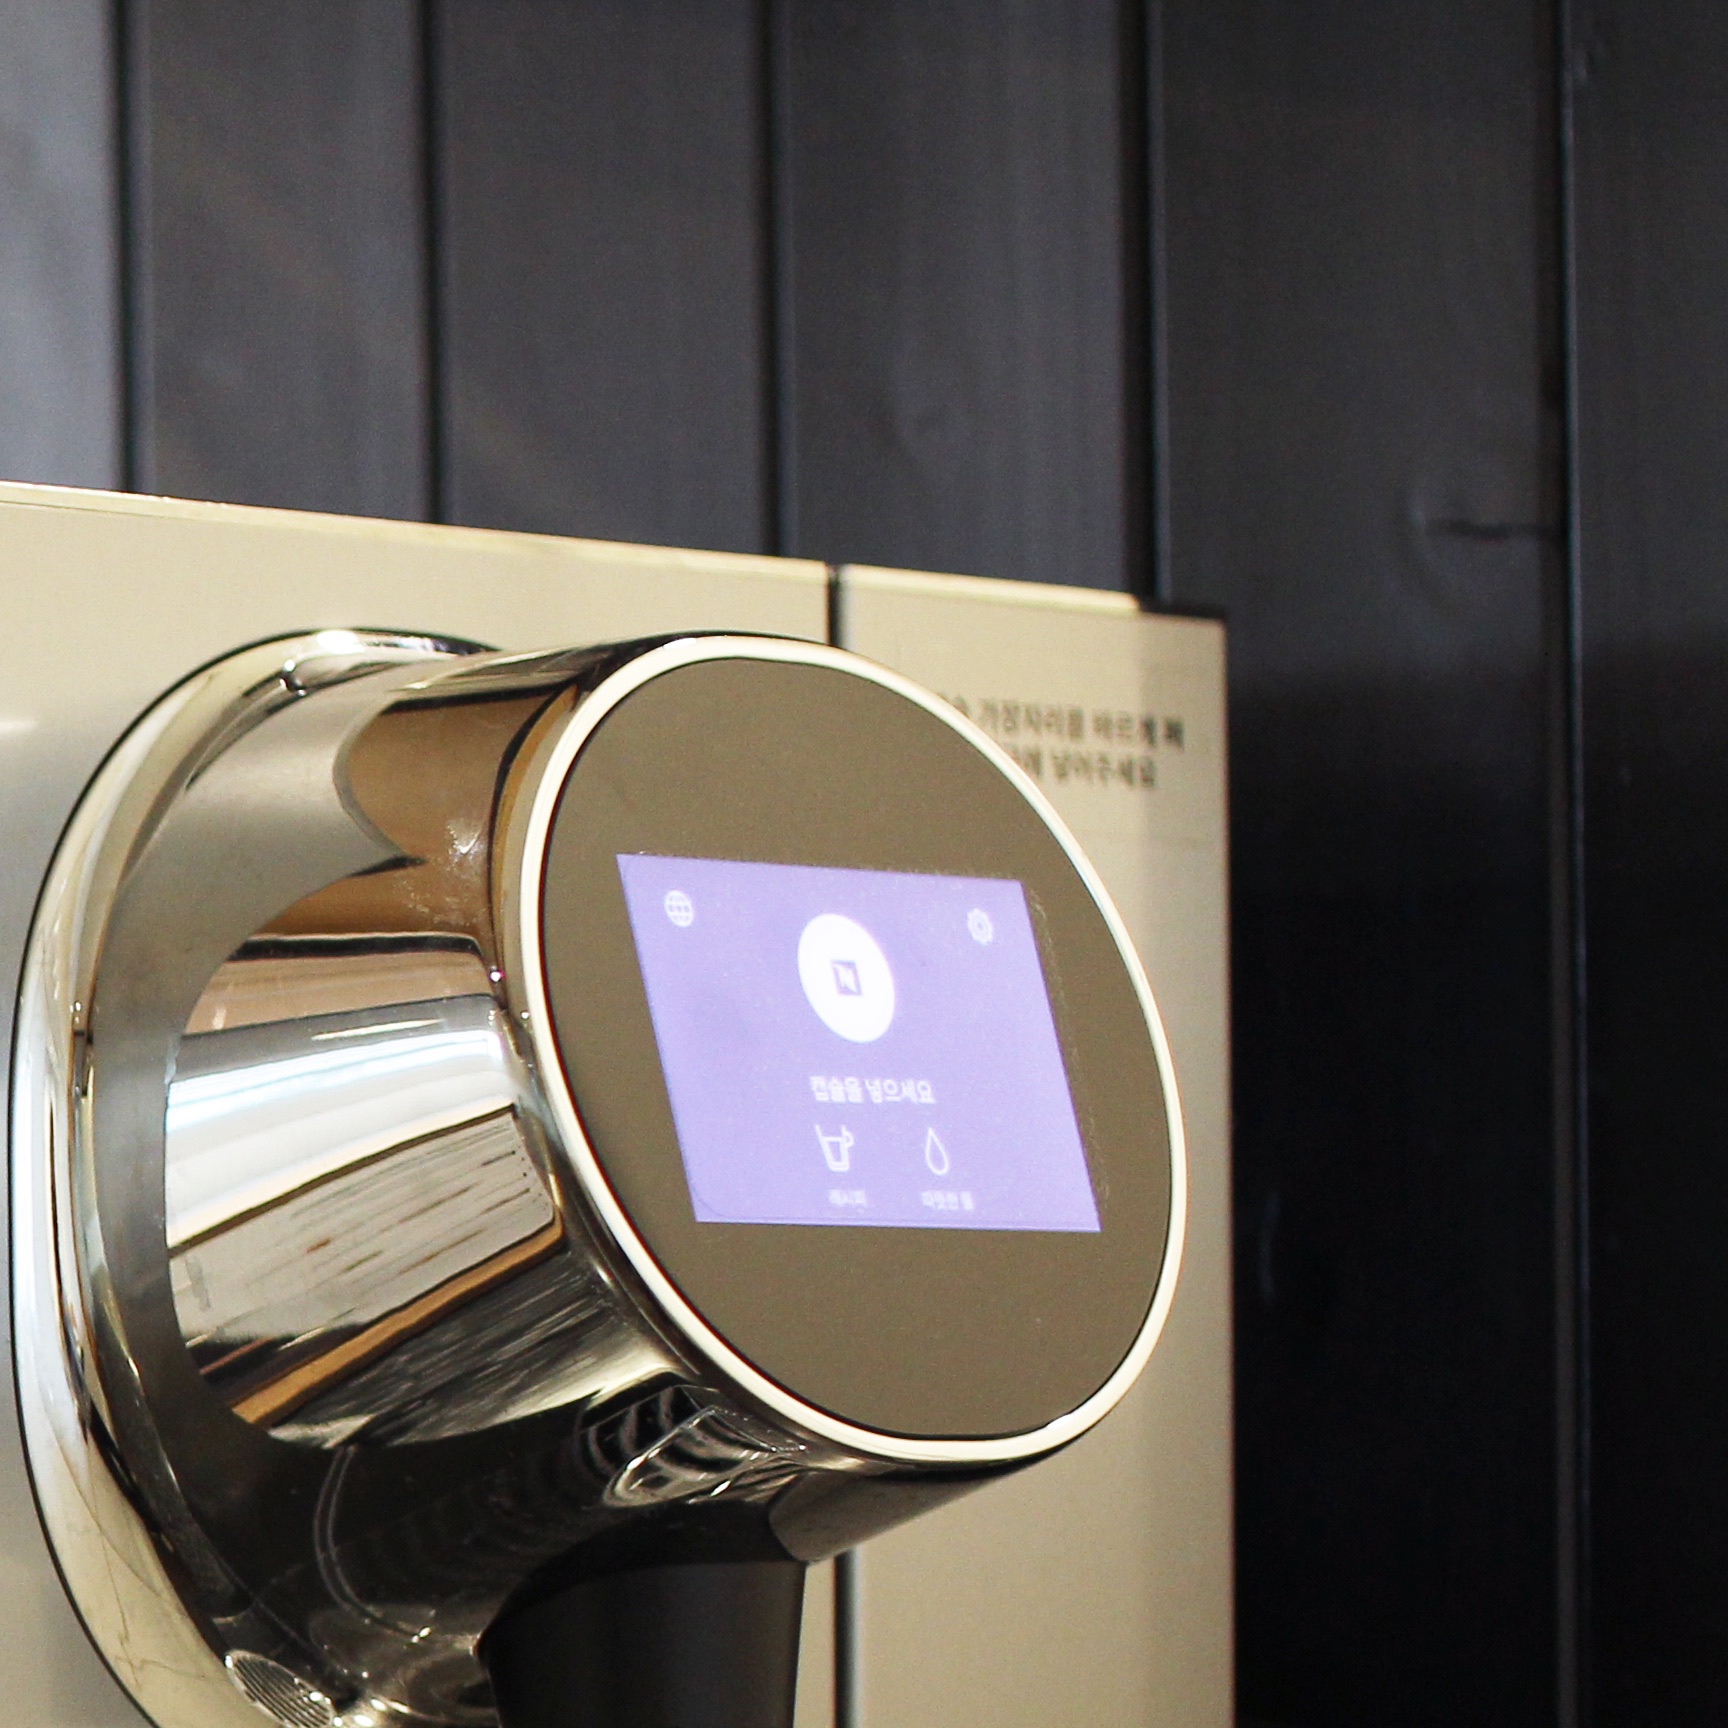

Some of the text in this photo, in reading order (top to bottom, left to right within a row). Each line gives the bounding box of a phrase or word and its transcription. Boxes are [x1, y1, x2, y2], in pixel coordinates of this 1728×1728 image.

[978, 699, 1084, 741] 가장자리를
[1052, 750, 1157, 788] 넣어주세요
[810, 1075, 936, 1104] 캡슐을 넣으세요
